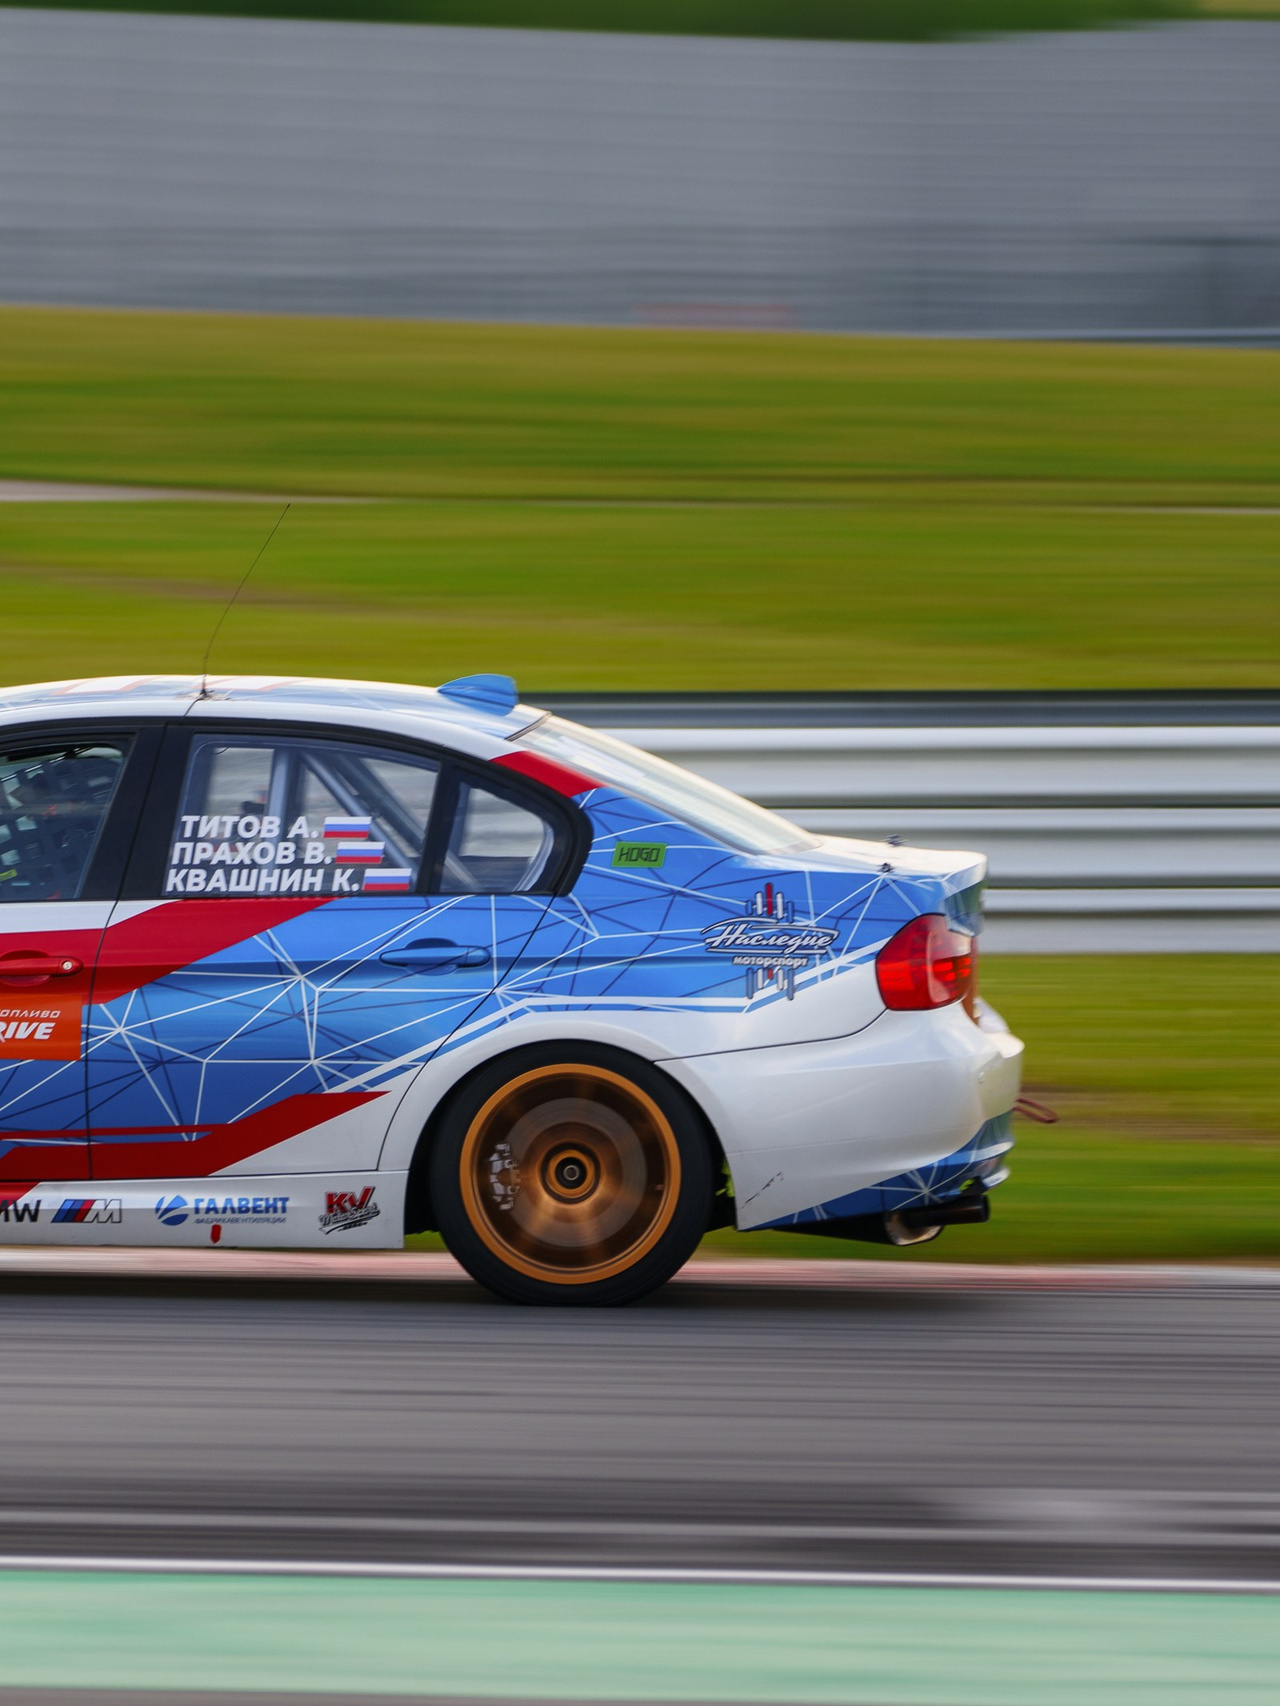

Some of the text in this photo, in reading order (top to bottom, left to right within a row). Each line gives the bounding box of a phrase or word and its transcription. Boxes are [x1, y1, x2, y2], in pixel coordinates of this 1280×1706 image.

[180, 815, 319, 839] ТИТОВ А.
[170, 842, 333, 865] ПРАХОВ В.
[619, 846, 661, 863] HOGO
[166, 868, 360, 893] КВАШНИН К.
[704, 923, 834, 954] Наследие
[193, 1197, 290, 1215] ГАЛВЕНТ
